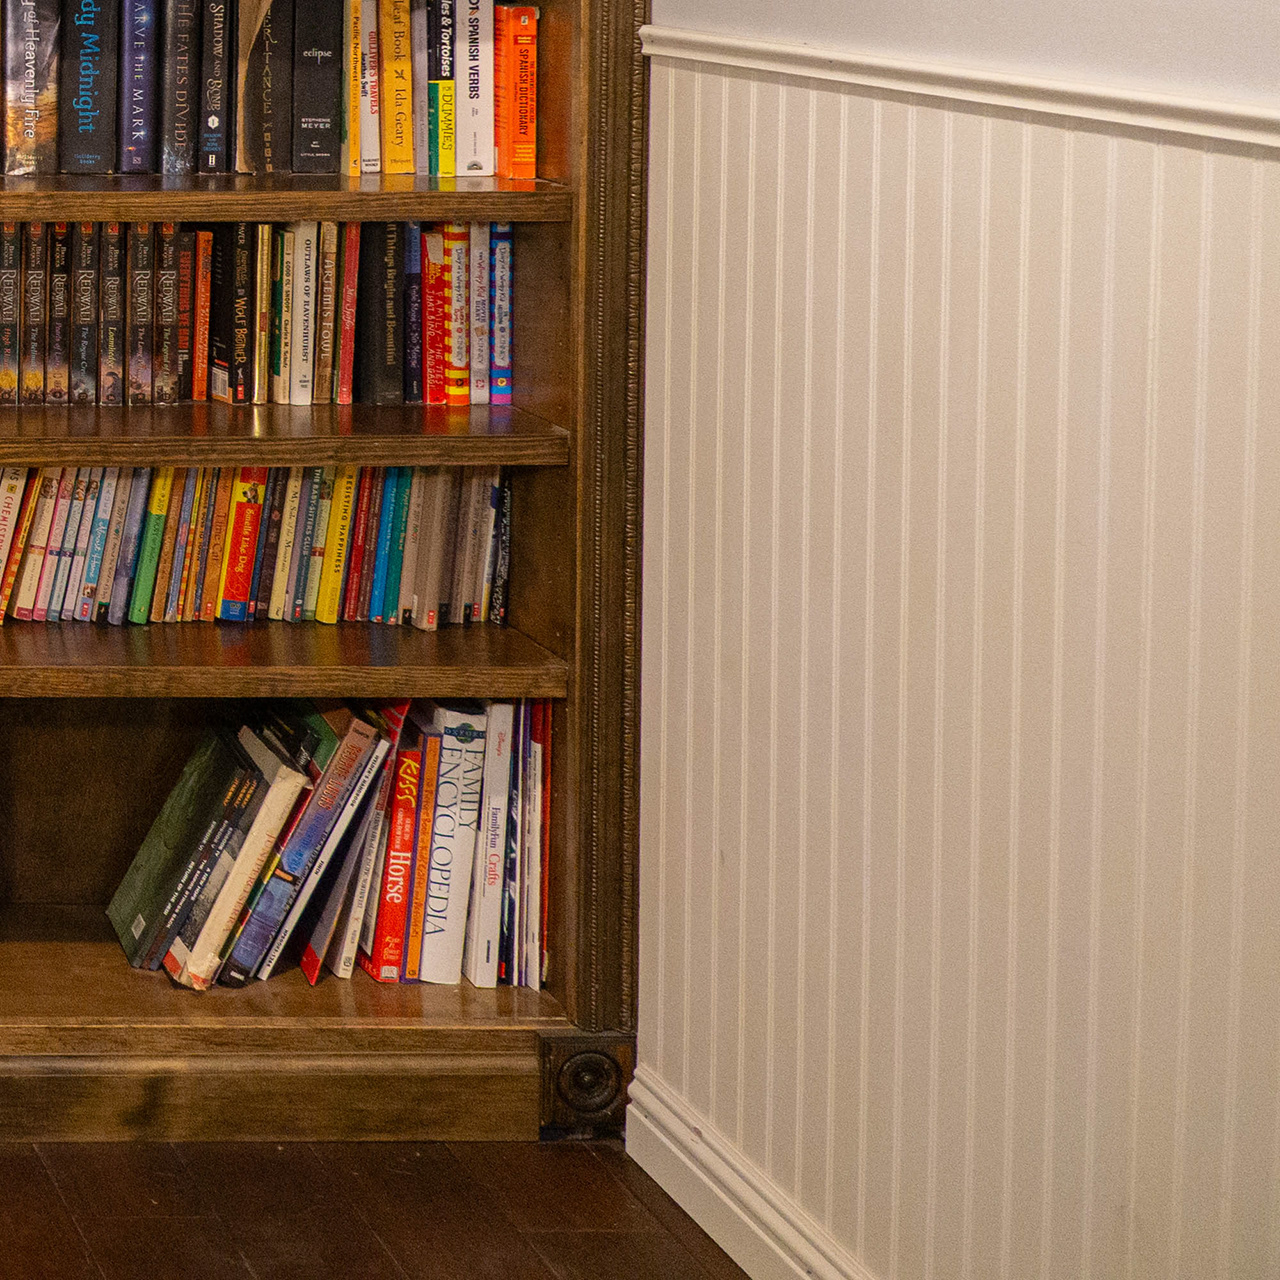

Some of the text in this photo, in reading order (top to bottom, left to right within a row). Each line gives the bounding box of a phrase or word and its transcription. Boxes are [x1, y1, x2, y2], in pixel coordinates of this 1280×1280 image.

[393, 0, 404, 26] Leaf
[468, 17, 479, 61] SPANISH
[393, 31, 405, 61] Book
[72, 32, 101, 133] Midnight
[394, 88, 406, 109] Ida
[469, 65, 480, 99] VERBS
[518, 48, 529, 135] SPANISH DICTIONARY
[392, 113, 406, 147] Geary
[159, 270, 177, 324] REDWALL
[301, 239, 312, 364] OUTLAWS OF RAVENHURST
[320, 259, 335, 359] ARTEMIS FOWL
[235, 508, 253, 573] Smells Like Dog
[458, 749, 483, 833] FAMILY
[424, 747, 462, 937] ENCYCLOPEDIA
[385, 850, 410, 904] Horse
